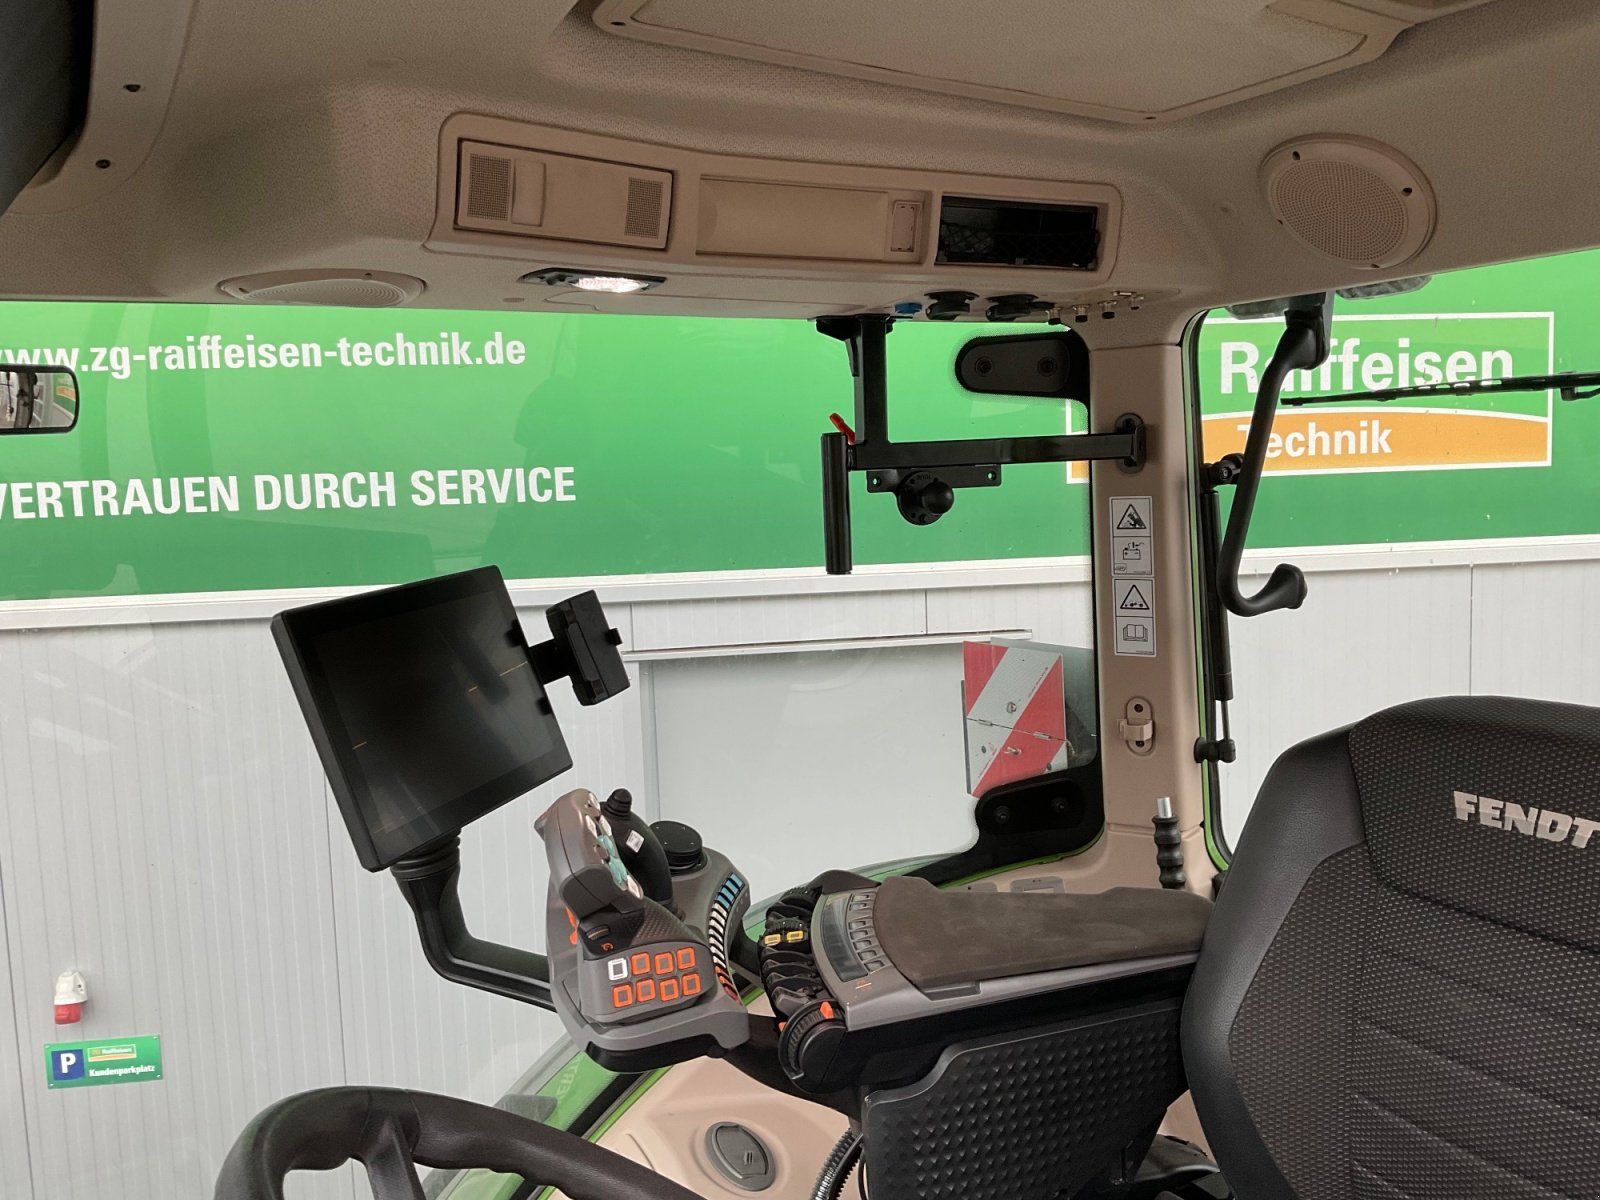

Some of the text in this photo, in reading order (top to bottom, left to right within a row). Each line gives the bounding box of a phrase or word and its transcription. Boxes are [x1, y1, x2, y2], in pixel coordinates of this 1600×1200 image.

[0, 331, 526, 379] ww.zg-raiffeisen-technik.de
[254, 471, 397, 511] DURCH
[410, 466, 577, 507] SERVICE
[1453, 790, 1600, 849] FENDT
[60, 1052, 77, 1074] P
